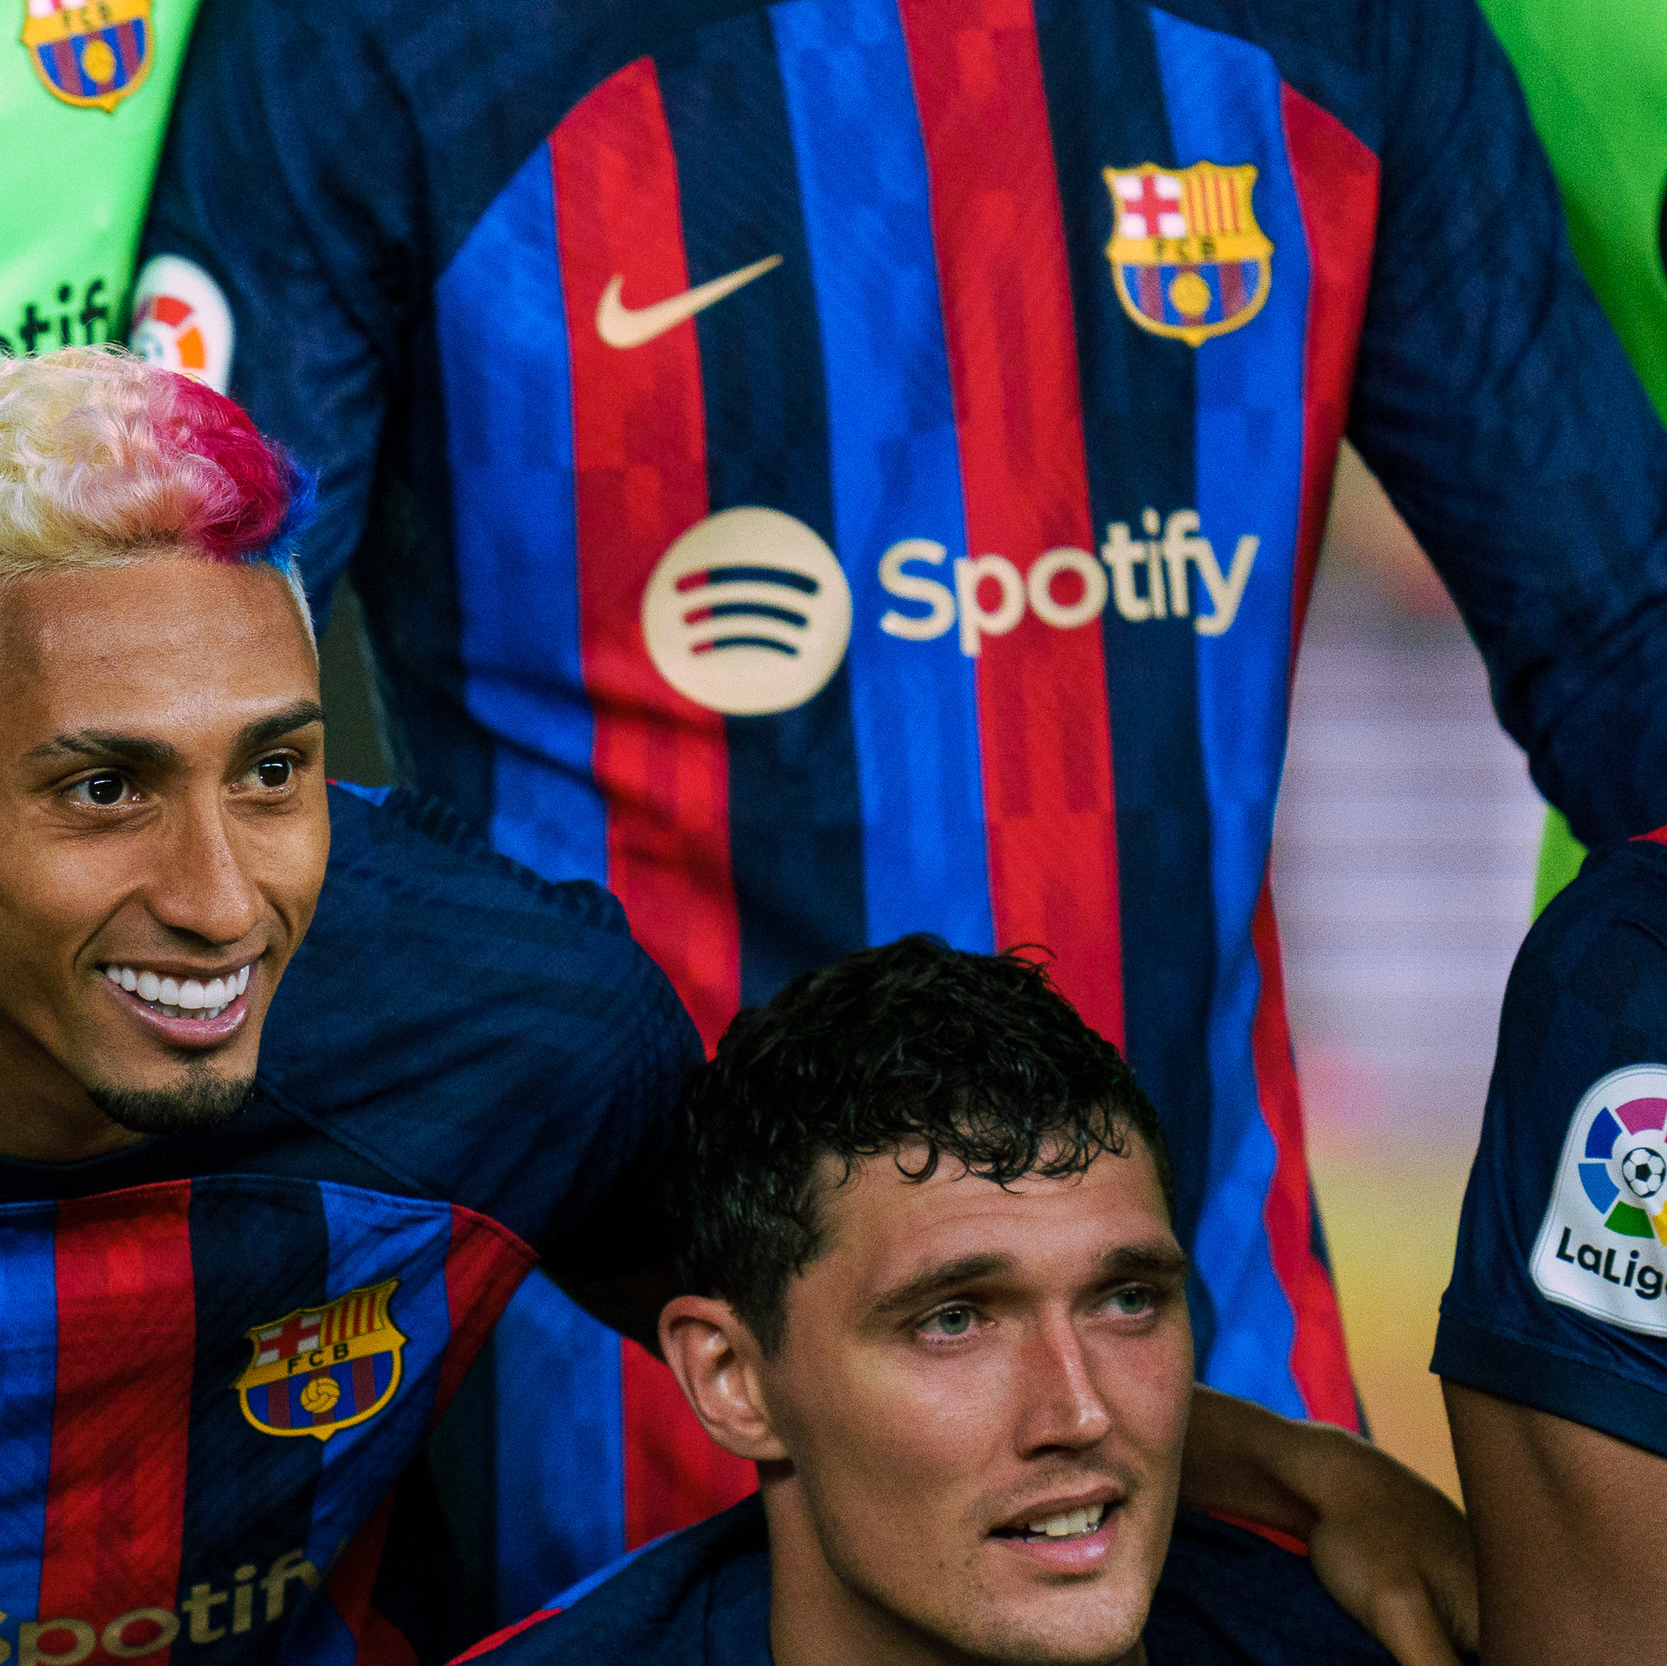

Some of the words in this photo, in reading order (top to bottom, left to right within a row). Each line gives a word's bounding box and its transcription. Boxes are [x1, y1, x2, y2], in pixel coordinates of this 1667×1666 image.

[878, 508, 1261, 657] Spotify
[1556, 1226, 1667, 1301] LaLig
[288, 1343, 349, 1374] FCB
